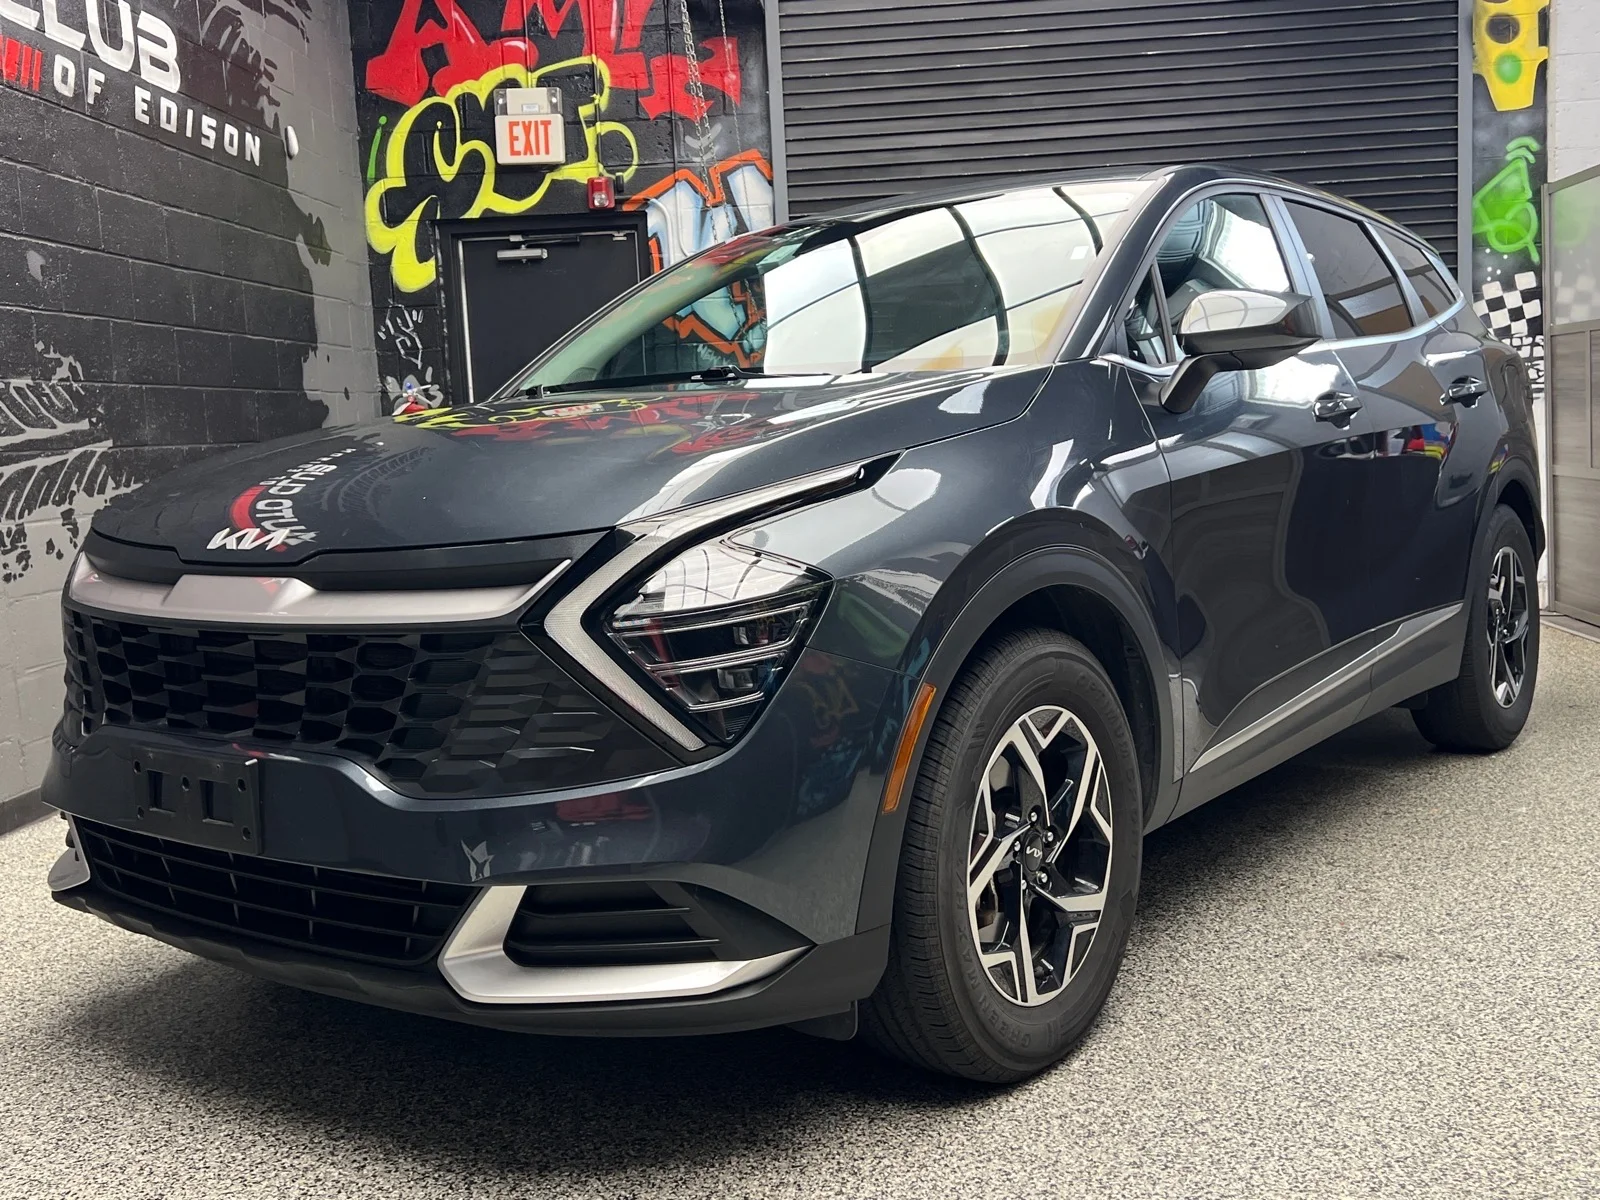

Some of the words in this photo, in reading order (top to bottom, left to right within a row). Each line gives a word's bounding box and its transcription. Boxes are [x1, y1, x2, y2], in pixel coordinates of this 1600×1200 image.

[53, 54, 105, 104] OF
[134, 85, 260, 166] EDISON
[508, 120, 552, 156] EXIT
[206, 527, 291, 550] KIA
[956, 924, 981, 989] MAX
[977, 993, 1032, 1048] GREEN
